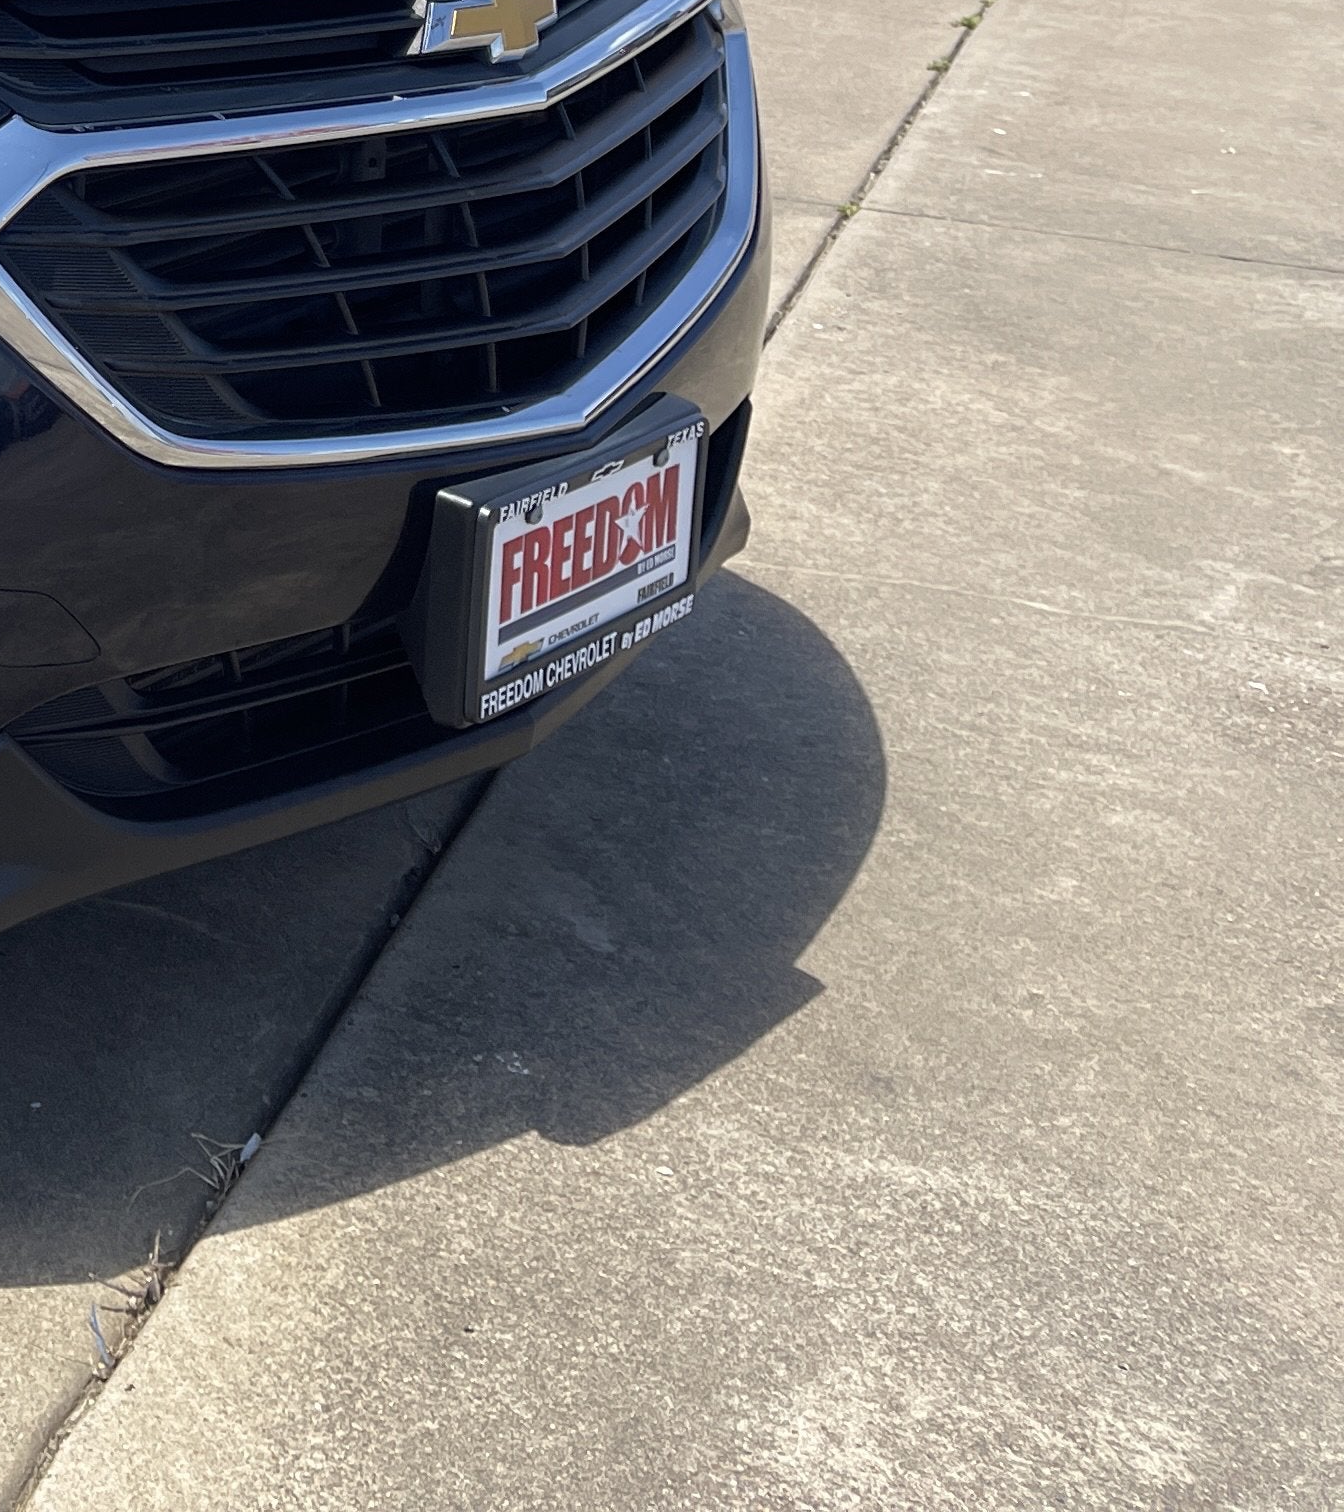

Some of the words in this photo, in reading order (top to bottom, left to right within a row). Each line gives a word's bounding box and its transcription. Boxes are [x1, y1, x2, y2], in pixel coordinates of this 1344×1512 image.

[666, 421, 705, 449] TEXAS
[499, 482, 569, 524] FAIRFIELD
[499, 463, 681, 625] FREEDOM
[548, 613, 600, 645] CHEVROLET
[480, 668, 545, 720] FREEDOM
[545, 631, 618, 687] CHEVROLET
[633, 617, 652, 644] ED
[651, 593, 694, 635] MORSE
